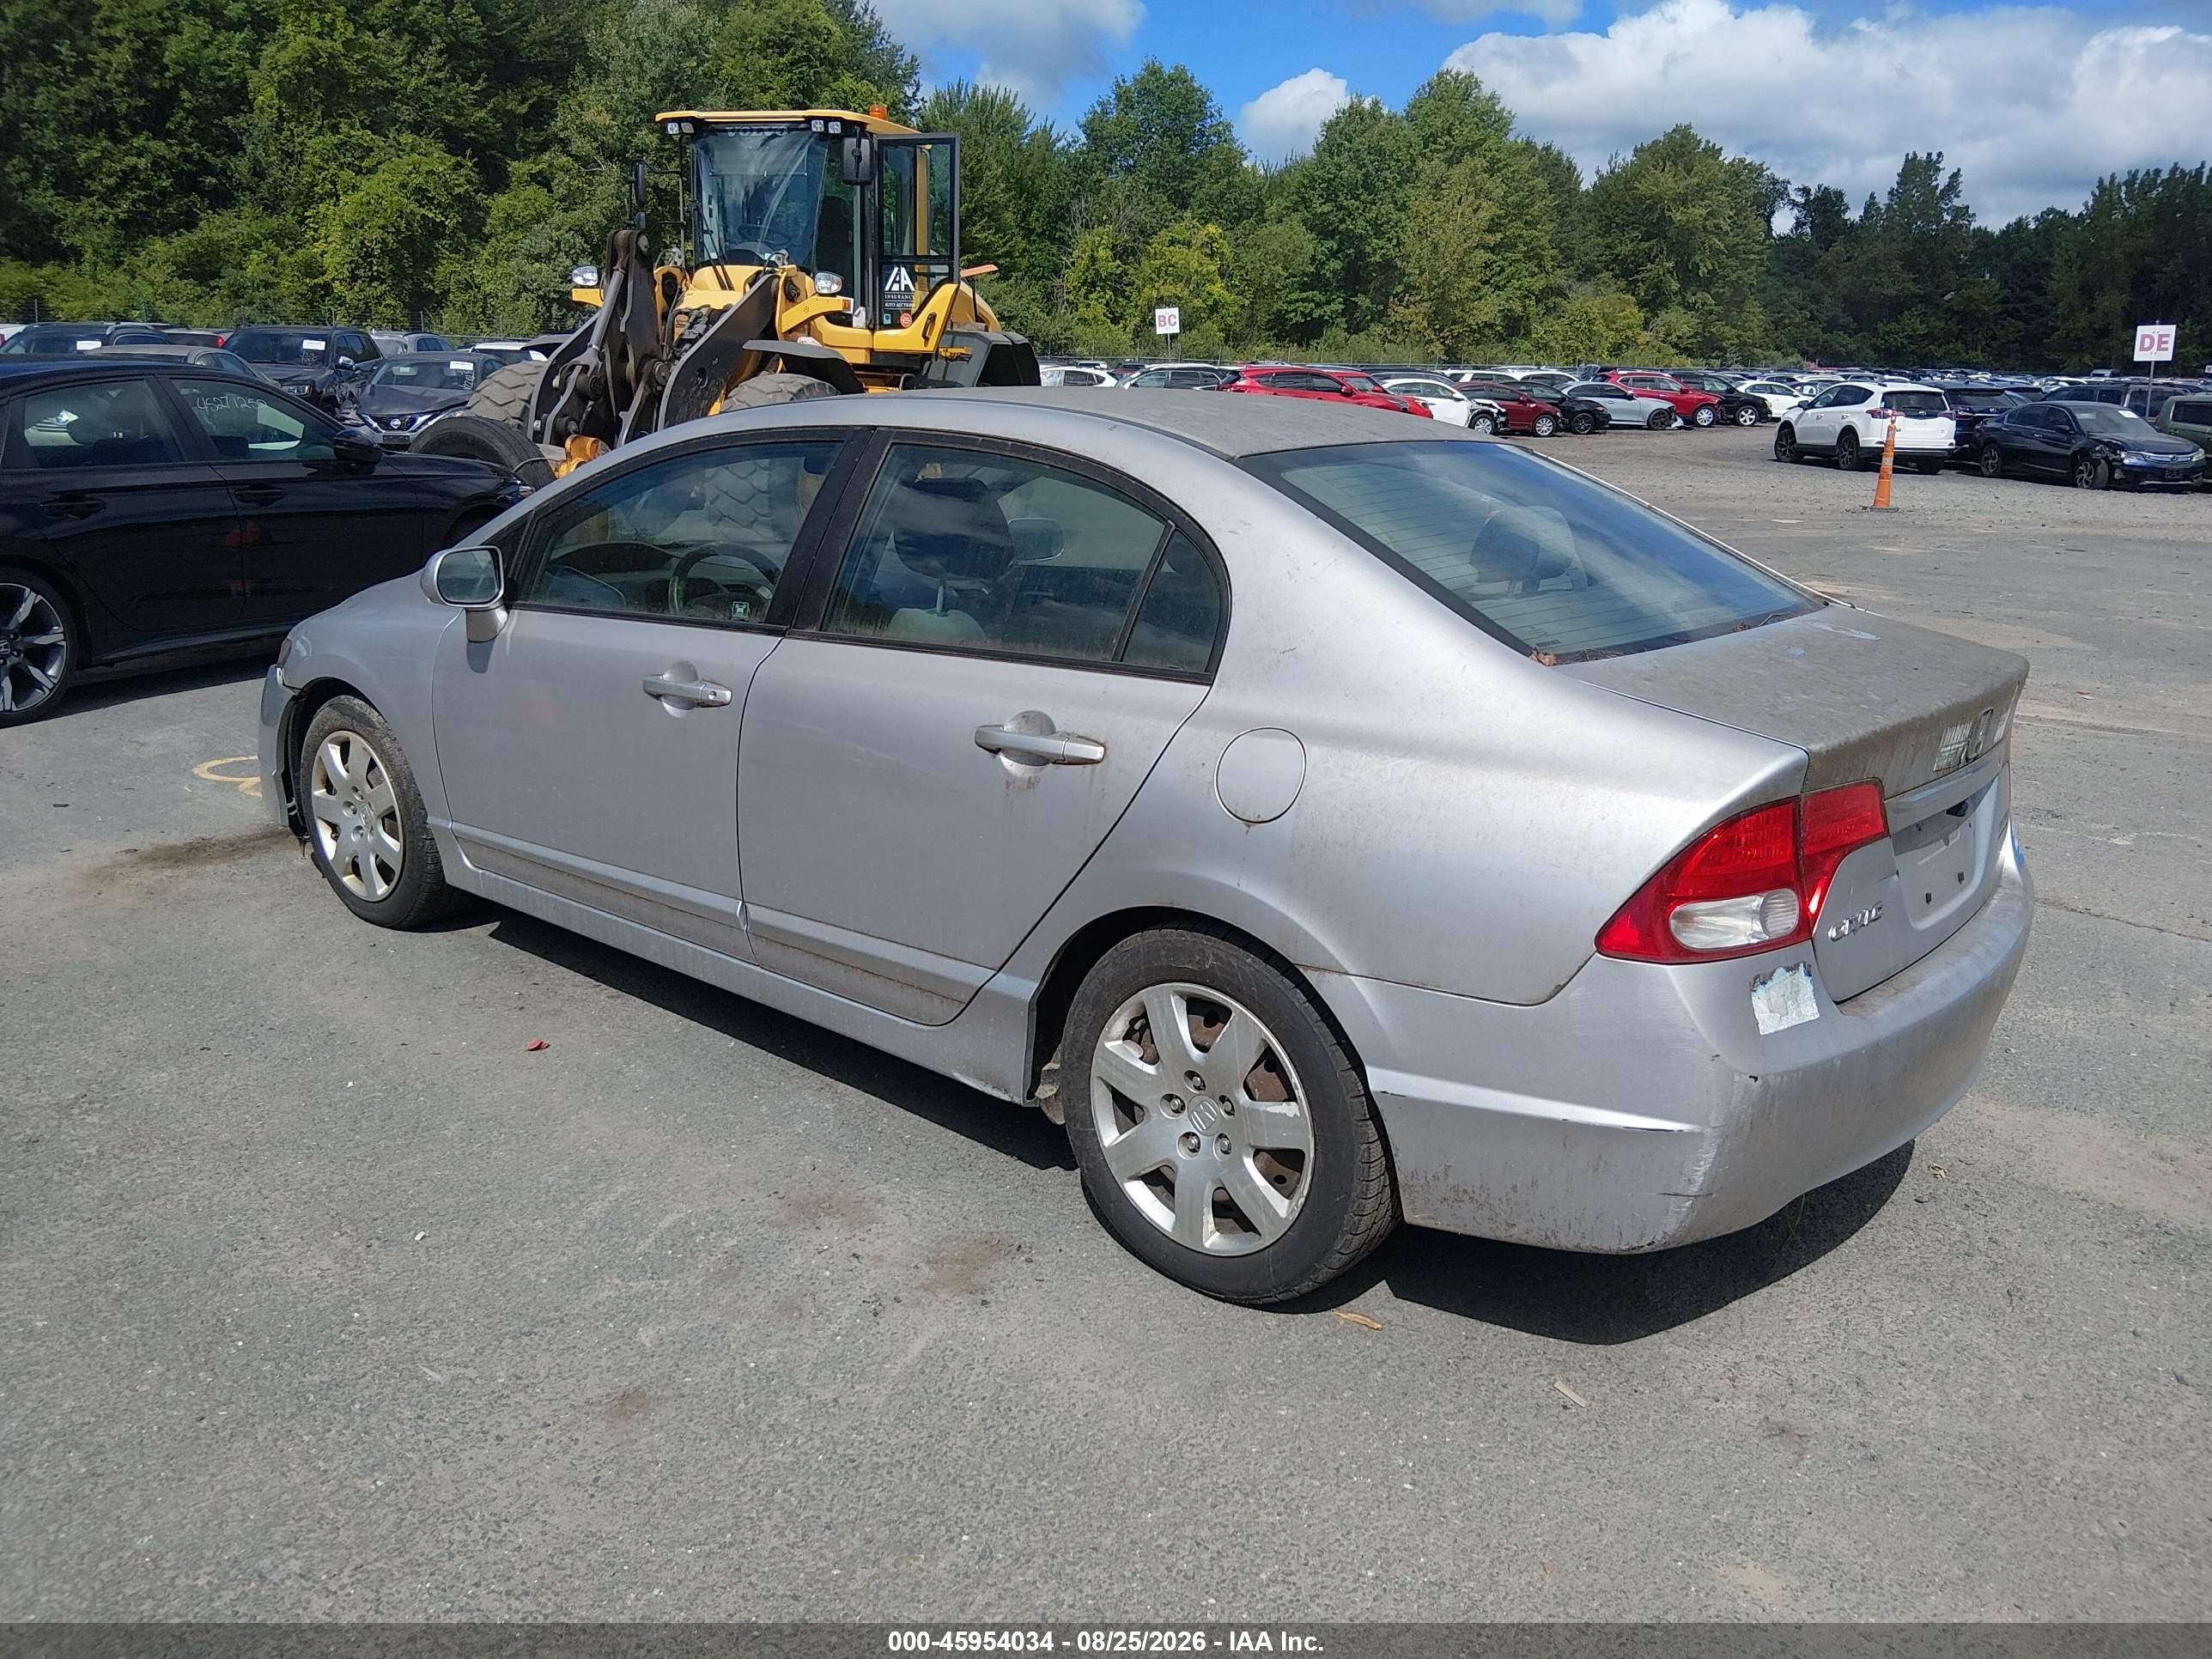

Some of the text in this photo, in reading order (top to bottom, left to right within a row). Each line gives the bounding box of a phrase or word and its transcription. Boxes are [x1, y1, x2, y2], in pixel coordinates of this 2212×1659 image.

[726, 125, 787, 137] VOLVO
[1158, 314, 1177, 327] BC
[2139, 333, 2171, 352] DE
